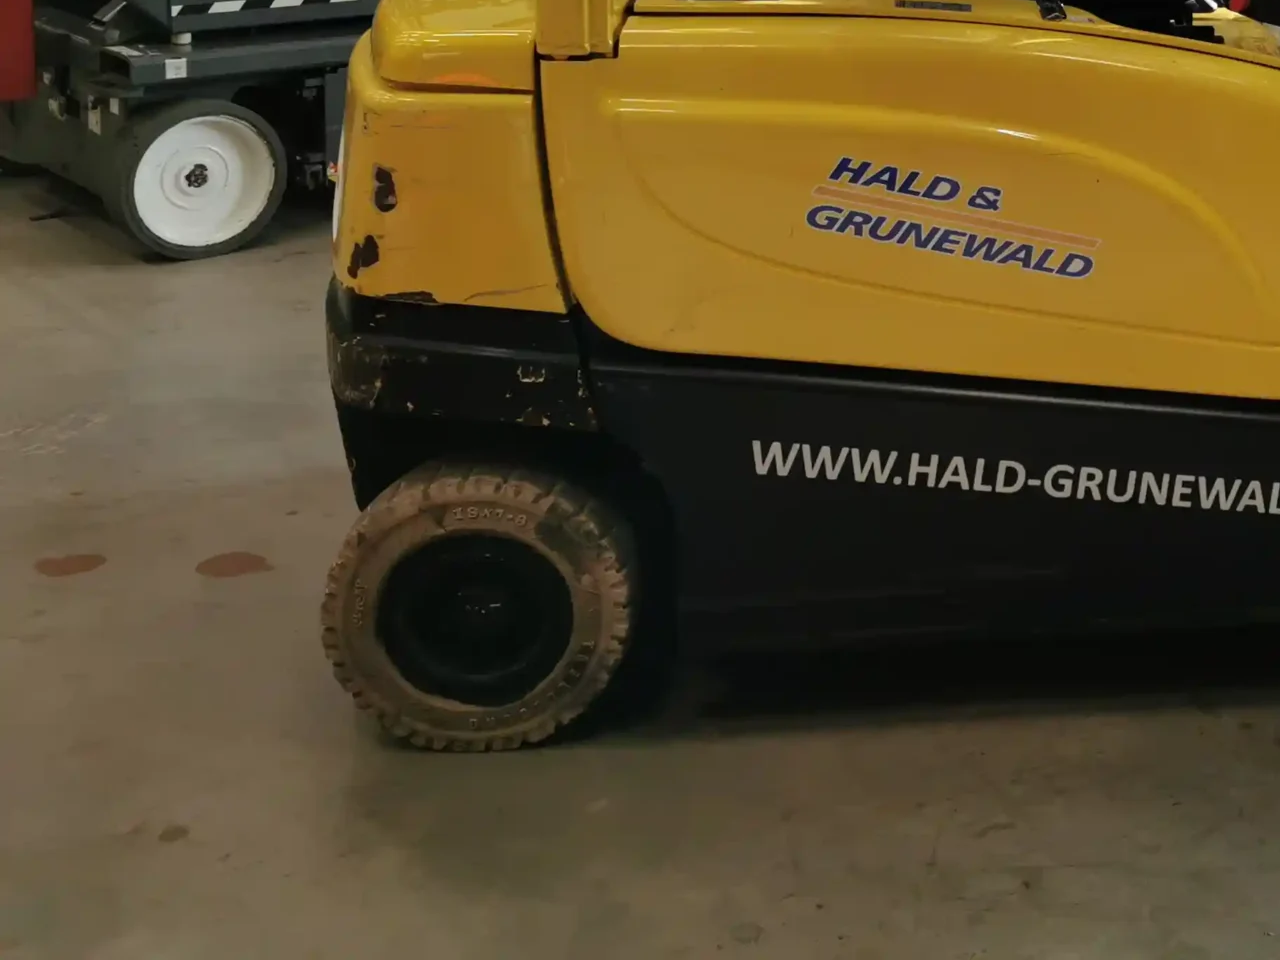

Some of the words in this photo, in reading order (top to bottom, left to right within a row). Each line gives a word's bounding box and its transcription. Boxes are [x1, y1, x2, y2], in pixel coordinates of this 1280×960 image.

[828, 156, 961, 202] HALD
[967, 185, 1002, 211] &
[805, 204, 1095, 278] GRUNEWALD
